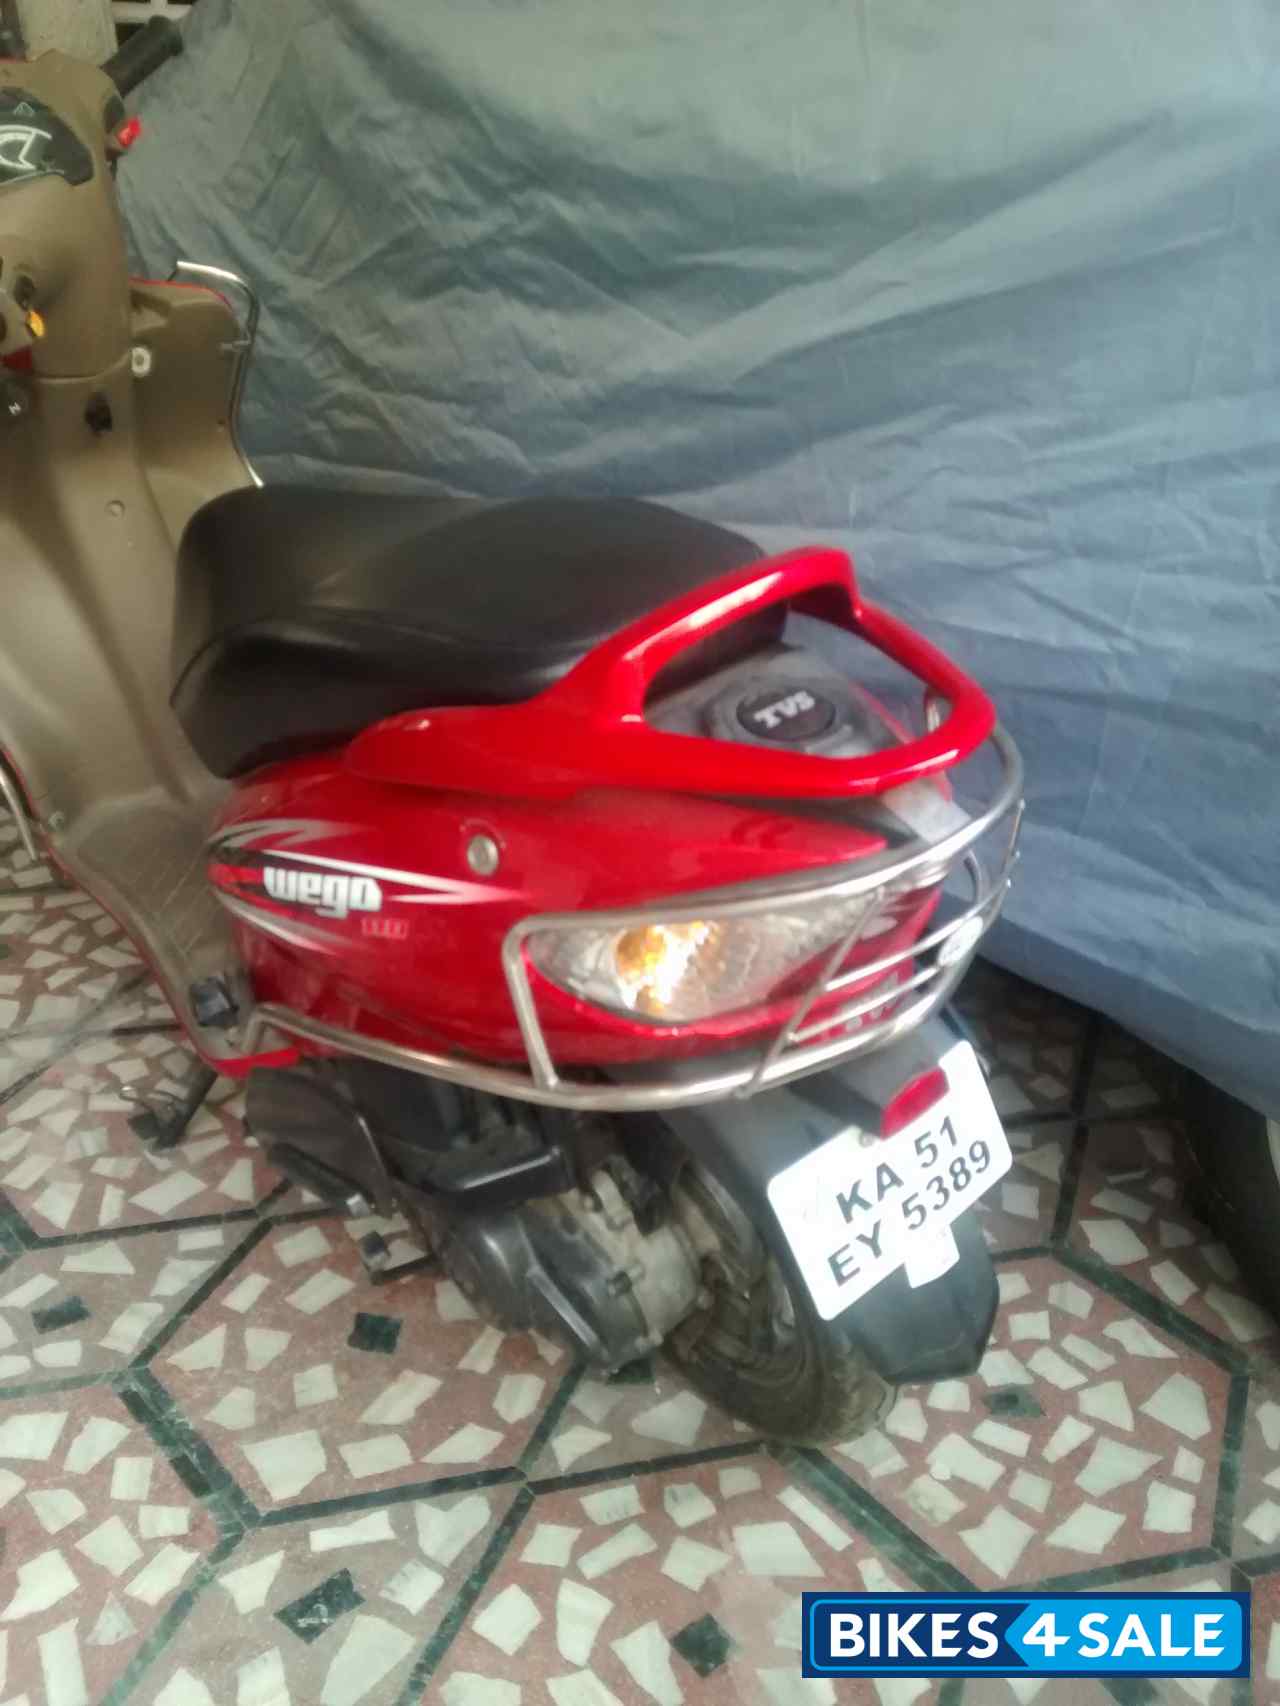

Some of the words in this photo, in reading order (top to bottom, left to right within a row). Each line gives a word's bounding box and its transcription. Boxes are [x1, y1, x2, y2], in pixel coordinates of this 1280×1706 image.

[753, 690, 815, 728] TVS
[827, 1221, 882, 1287] EY
[901, 1140, 991, 1230] 5389
[836, 1162, 904, 1224] KA
[914, 1116, 958, 1168] 51
